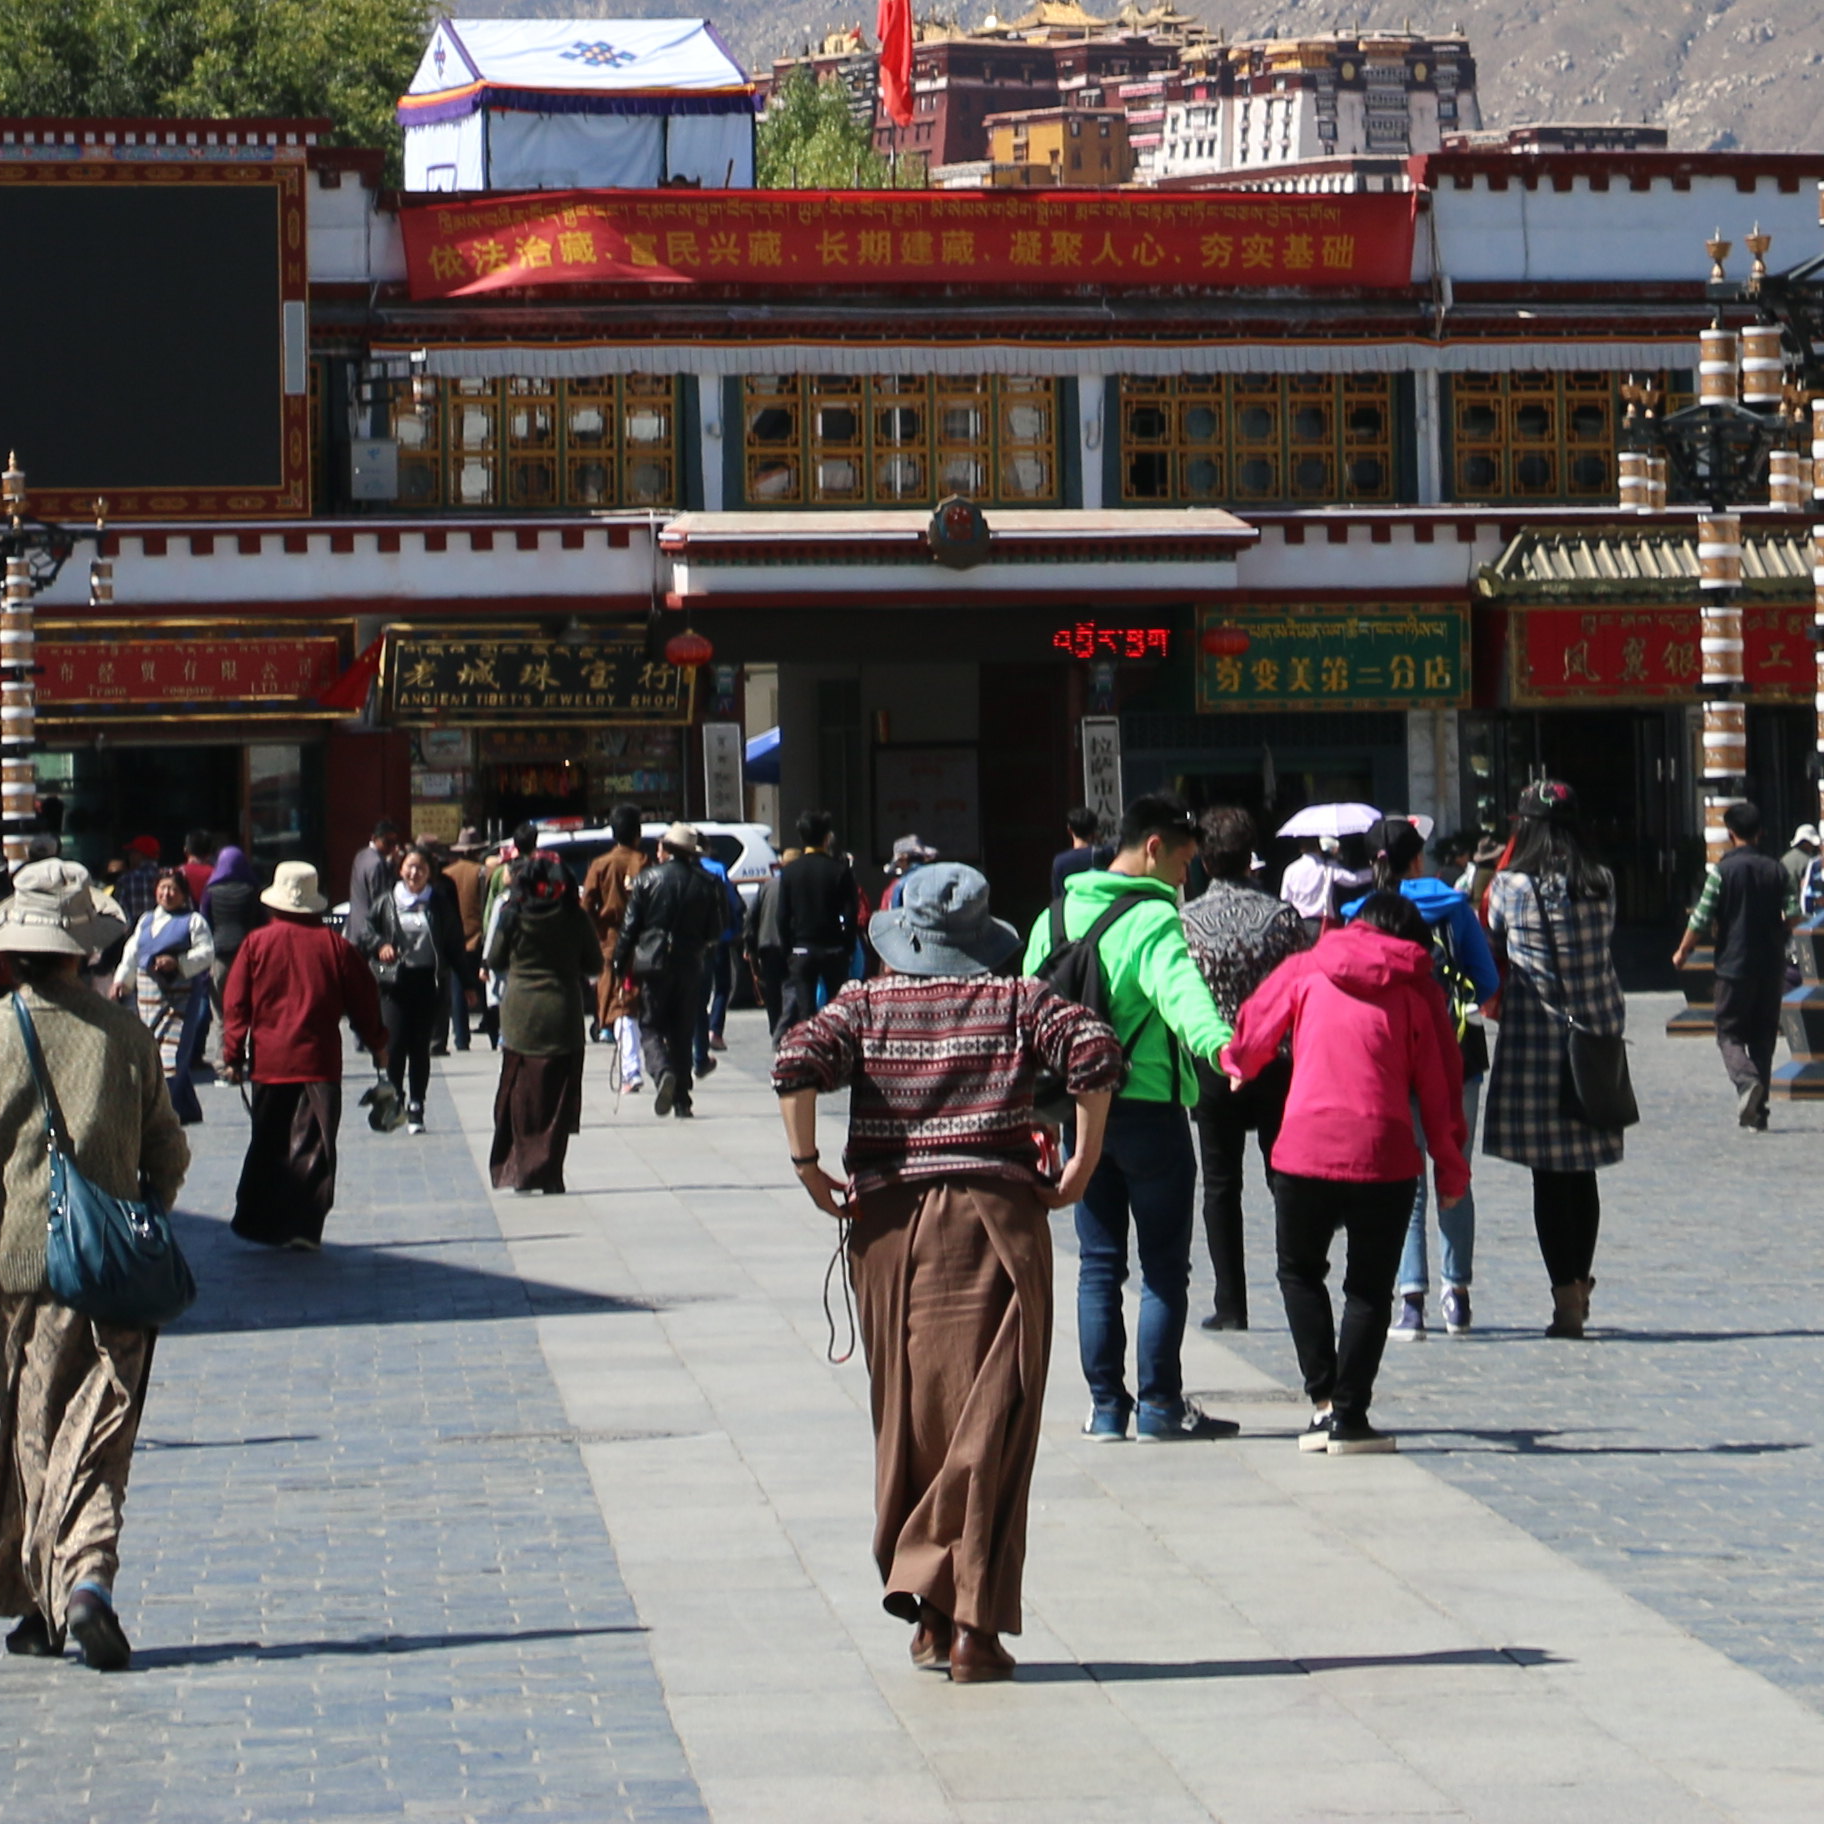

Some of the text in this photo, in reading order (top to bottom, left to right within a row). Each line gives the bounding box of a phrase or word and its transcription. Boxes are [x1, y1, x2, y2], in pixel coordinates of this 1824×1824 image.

[403, 656, 675, 691] 老城珠宝行
[400, 692, 676, 707] ANCIENT TIBET'S JEWELRY SHOP
